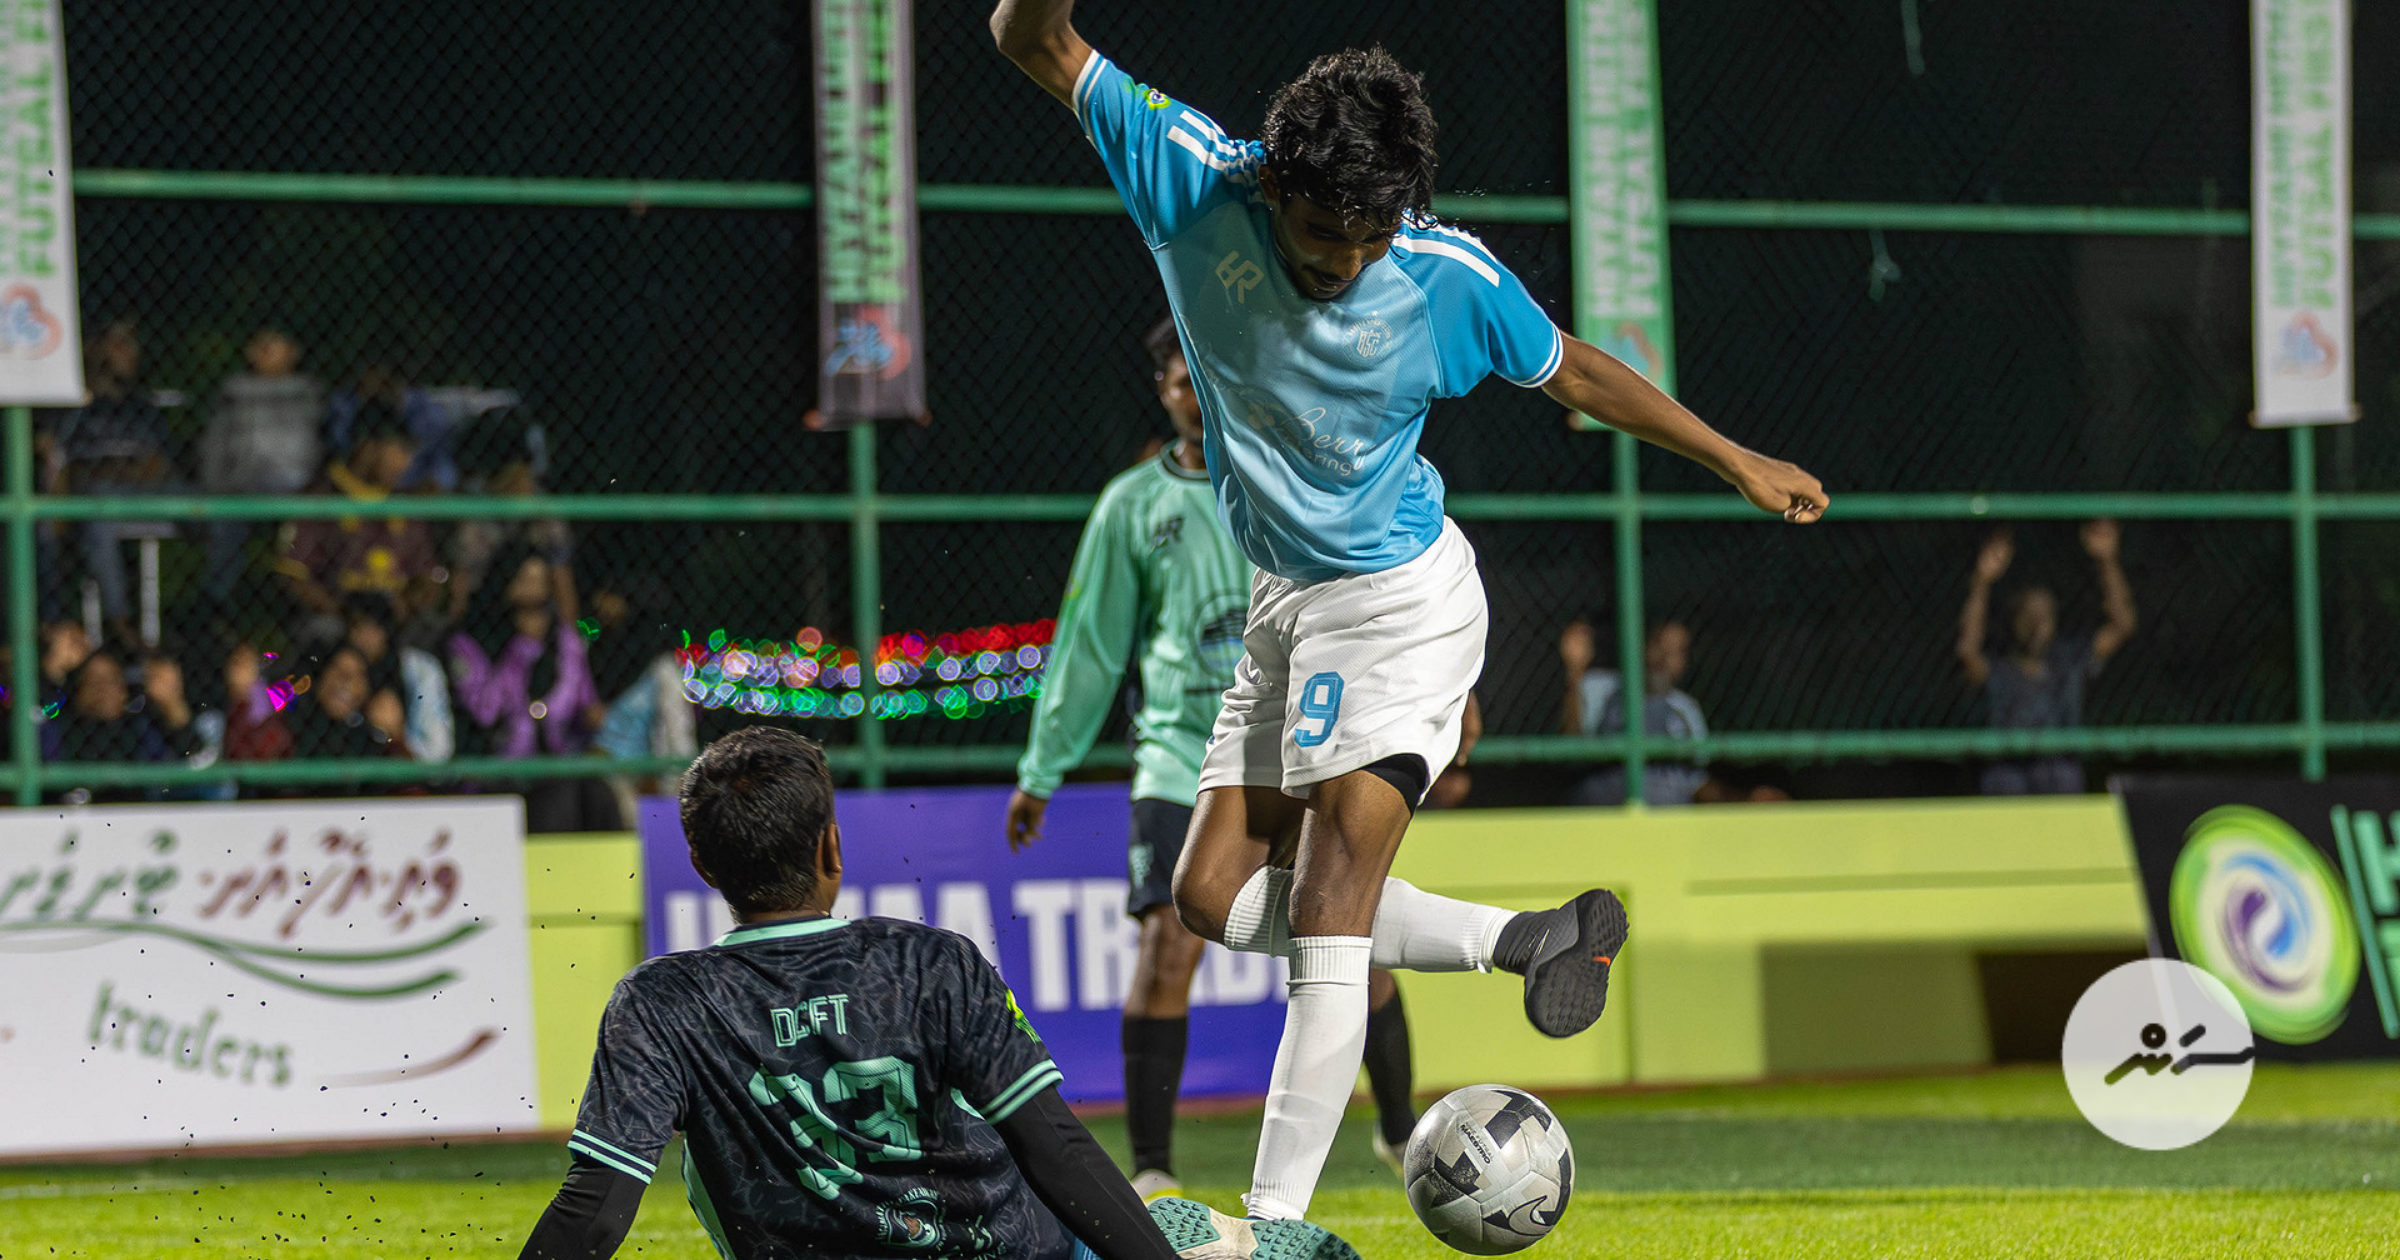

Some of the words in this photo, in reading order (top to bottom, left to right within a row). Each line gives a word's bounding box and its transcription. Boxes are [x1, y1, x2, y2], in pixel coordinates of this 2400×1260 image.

[15, 61, 57, 277] FUTSAL
[1293, 671, 1345, 748] 9
[748, 1055, 923, 1201] 33
[1459, 1123, 1491, 1165] MAESTRO
